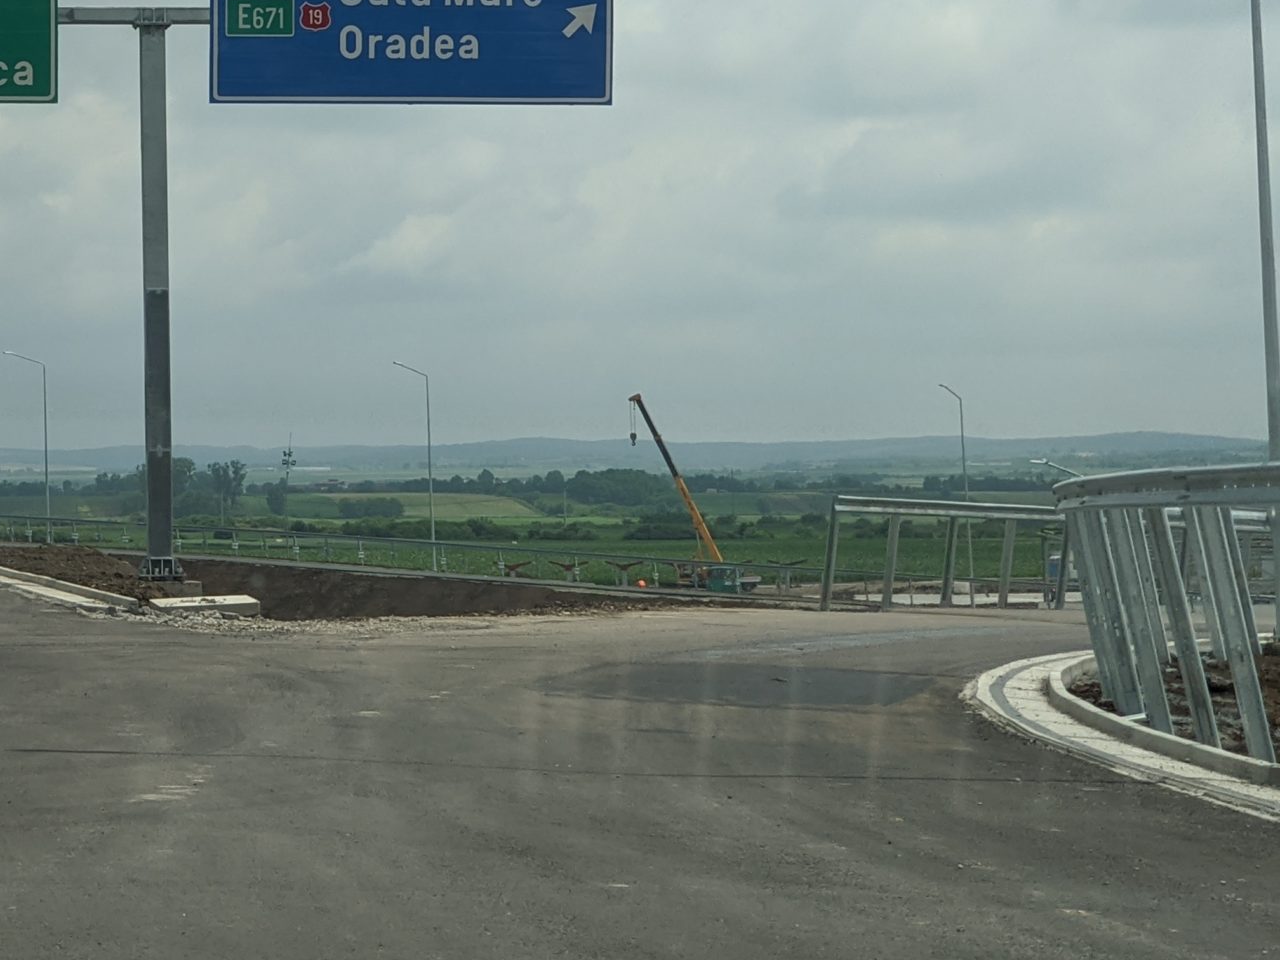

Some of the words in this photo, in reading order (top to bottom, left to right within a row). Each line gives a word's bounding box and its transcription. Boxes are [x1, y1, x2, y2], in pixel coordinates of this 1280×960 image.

[238, 3, 284, 29] E671
[308, 9, 323, 25] 19
[339, 25, 480, 60] Oradea
